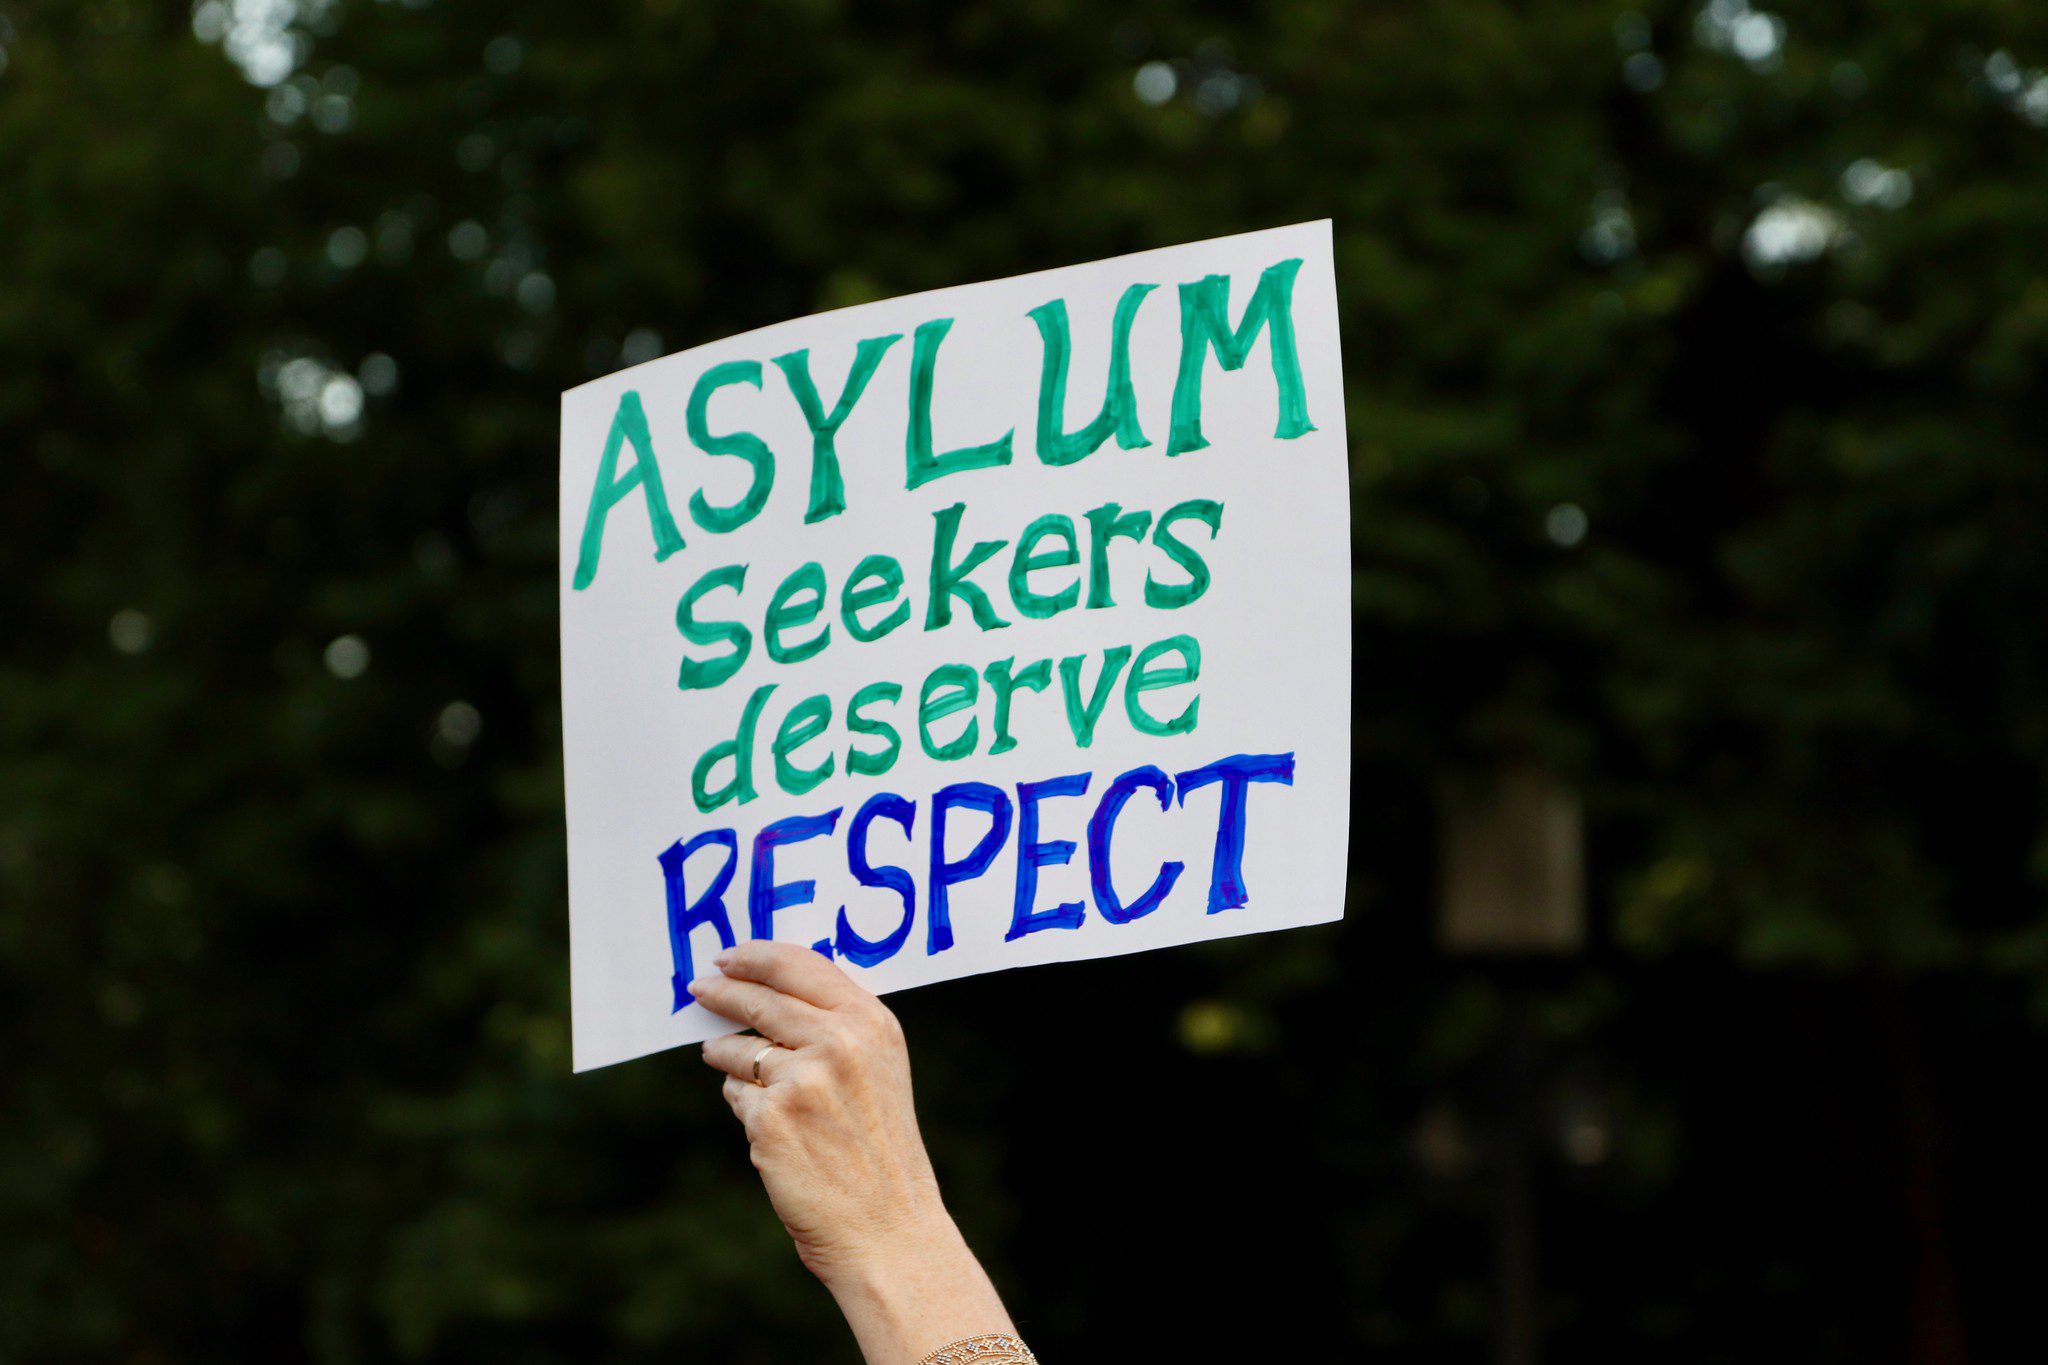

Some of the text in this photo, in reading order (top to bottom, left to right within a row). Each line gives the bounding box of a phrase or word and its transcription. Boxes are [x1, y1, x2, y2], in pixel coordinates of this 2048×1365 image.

[573, 258, 1316, 590] ASYLUM
[692, 634, 1201, 813] deserve
[657, 752, 1295, 1014] RESPECT
